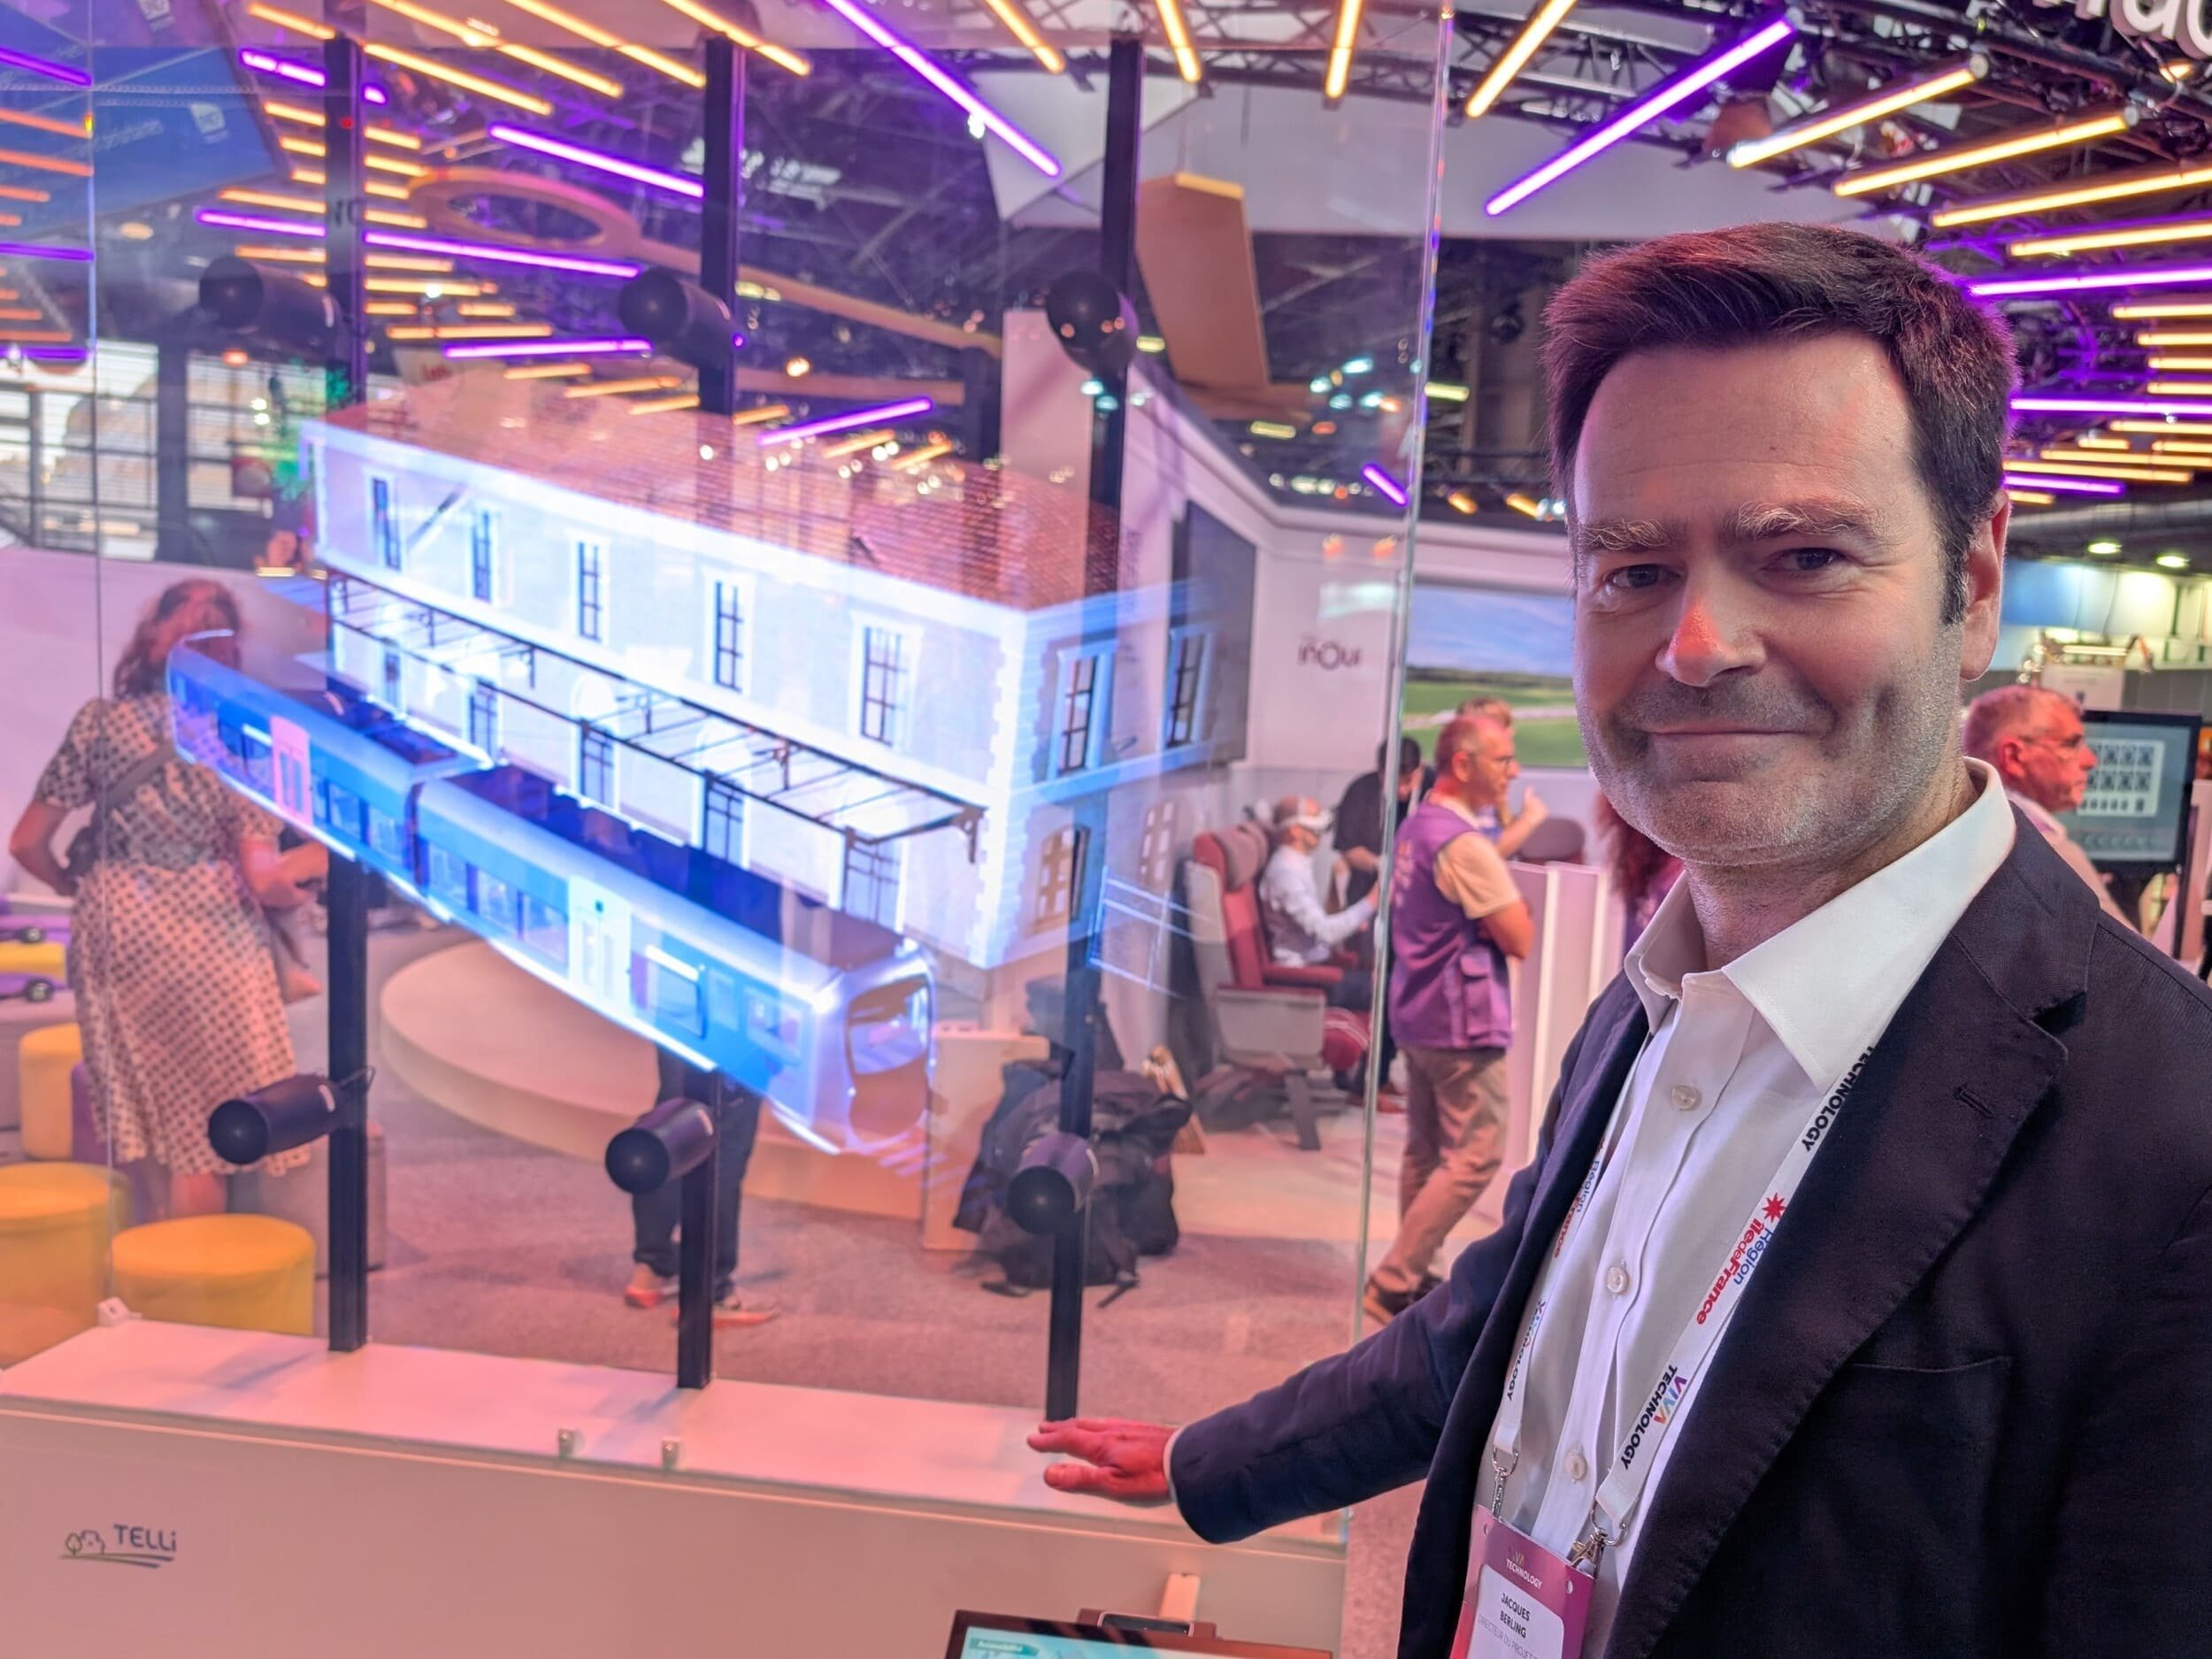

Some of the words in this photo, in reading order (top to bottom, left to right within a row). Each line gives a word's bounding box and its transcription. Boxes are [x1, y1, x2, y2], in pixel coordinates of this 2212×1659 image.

[1653, 1375, 1688, 1425] VIVA
[1620, 1364, 1678, 1471] TECHNOLOGY
[1506, 1558, 1543, 1589] TECHNOLOGY
[1501, 1592, 1532, 1622] JACQUES
[1499, 1609, 1527, 1639] BERLING
